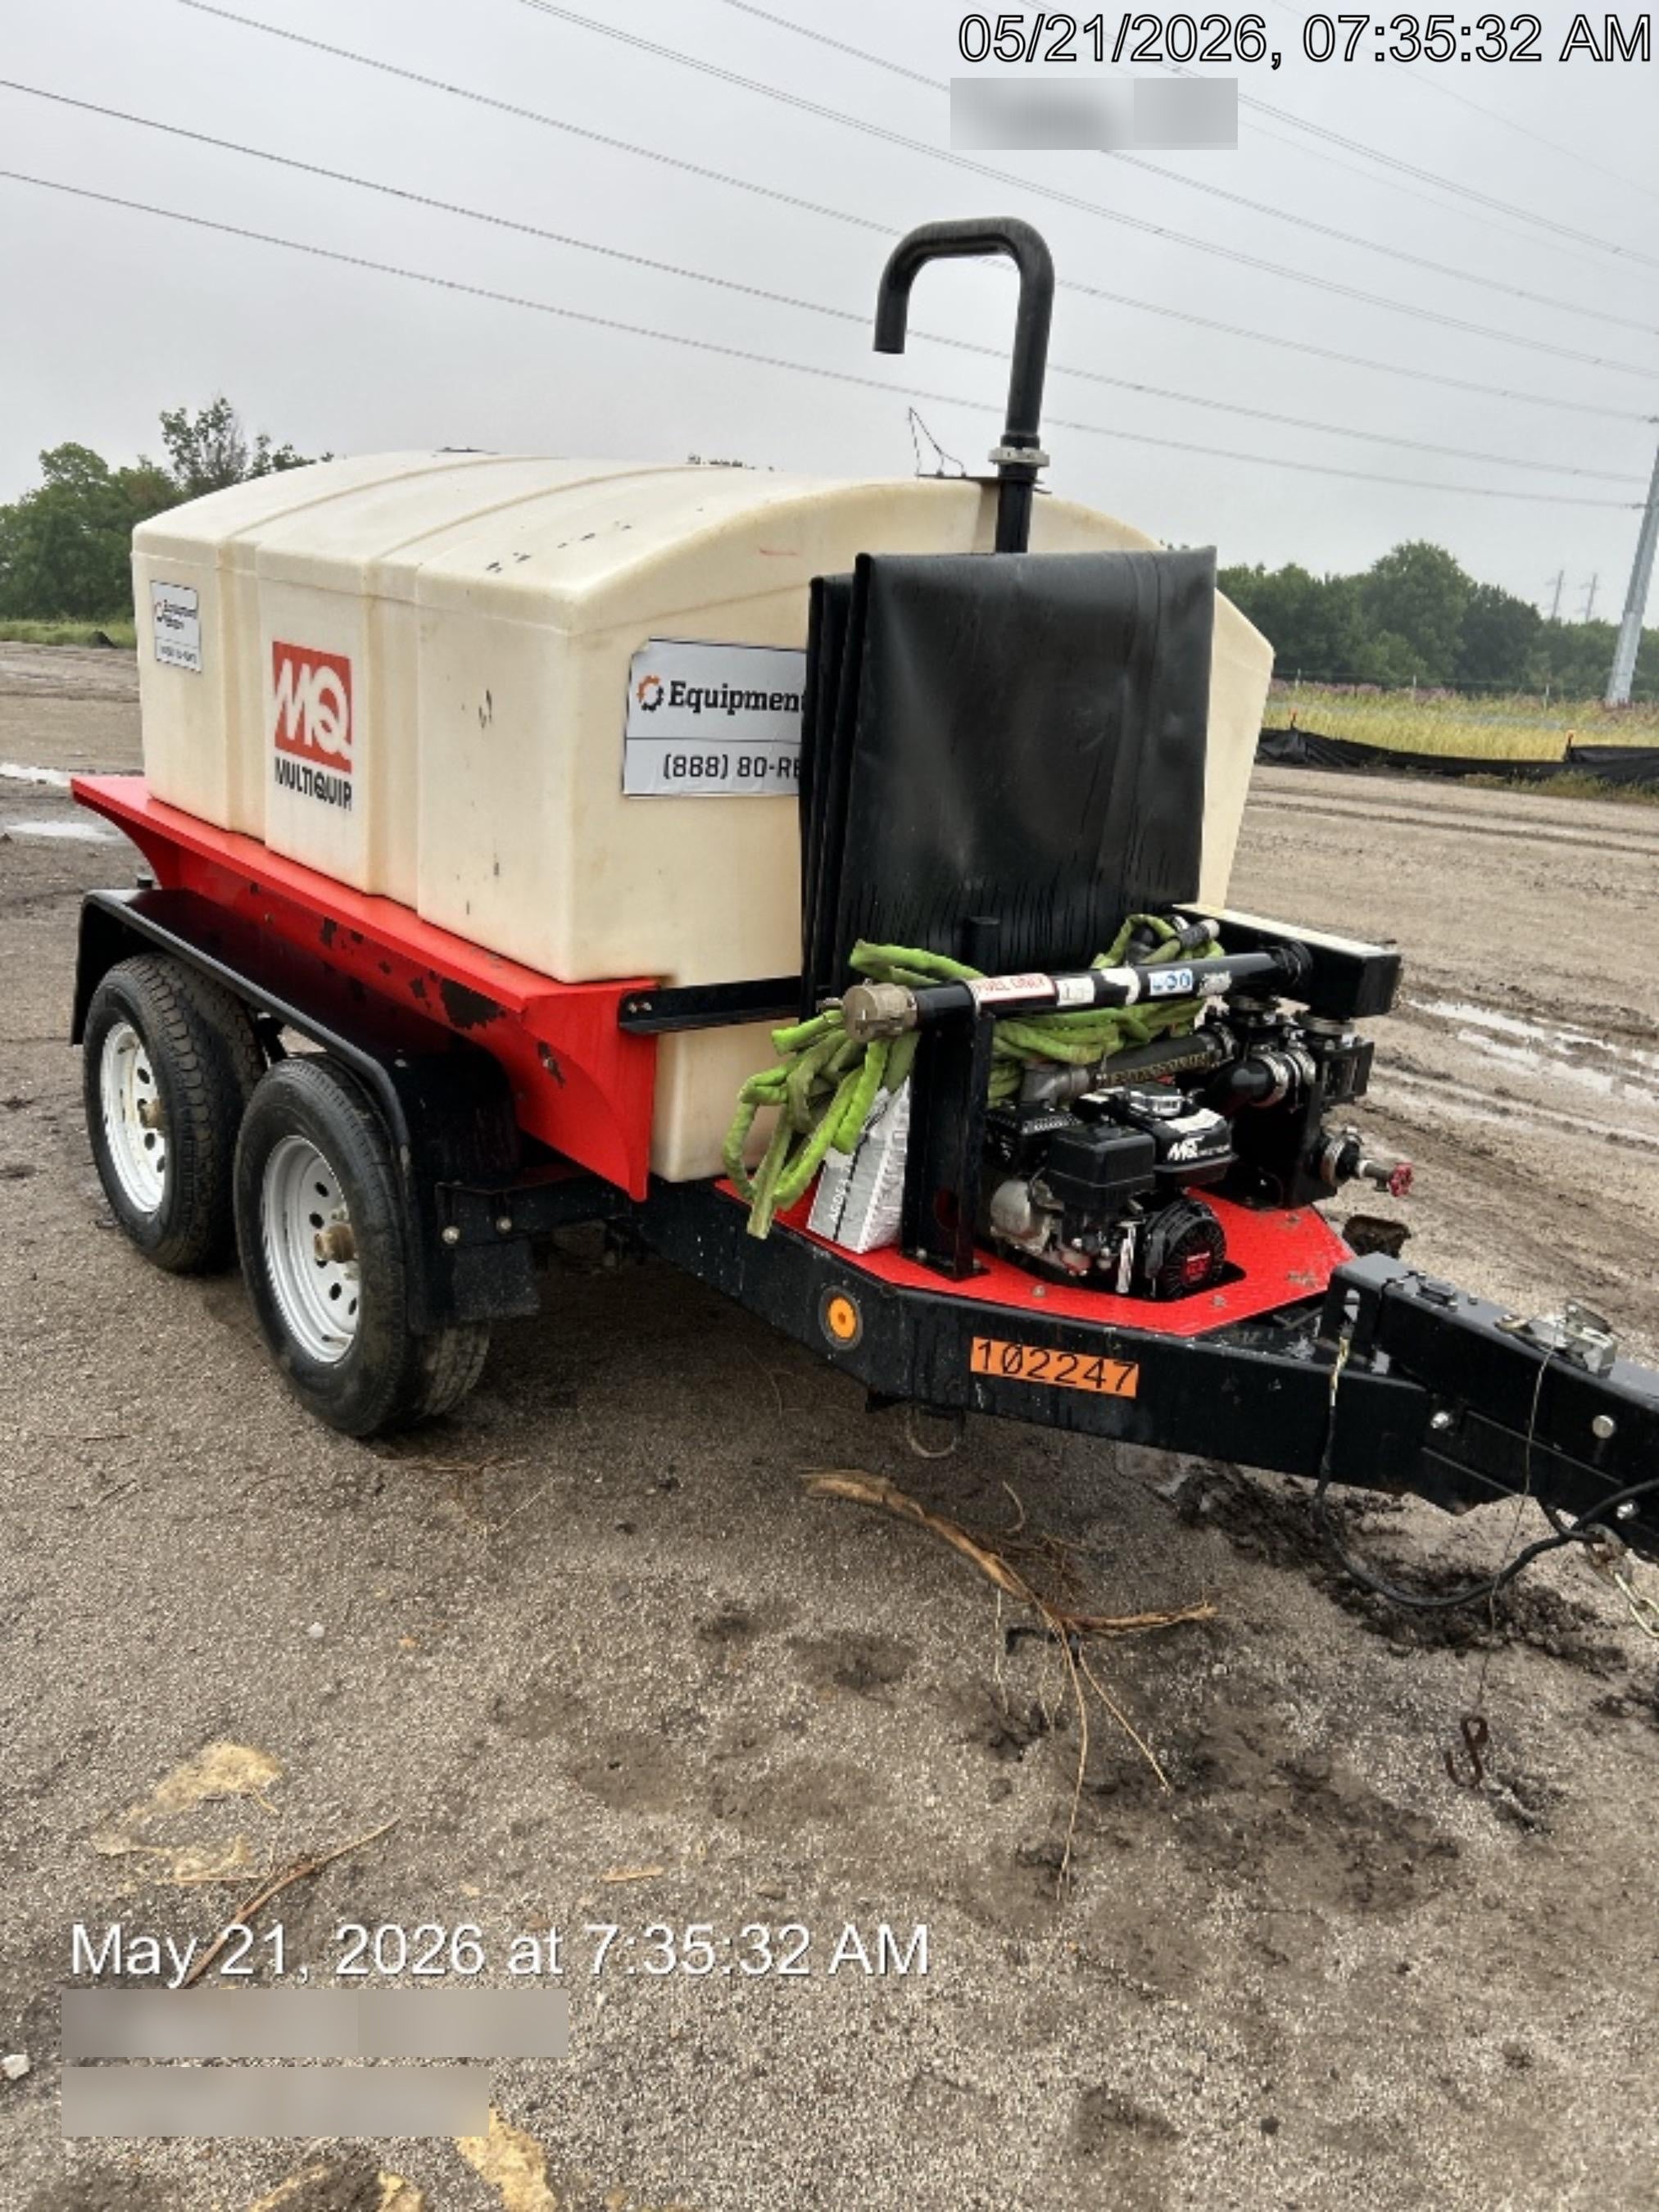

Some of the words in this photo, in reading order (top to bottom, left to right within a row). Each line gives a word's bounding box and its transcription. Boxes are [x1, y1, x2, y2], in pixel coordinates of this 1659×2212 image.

[273, 655, 352, 762] MQ
[668, 681, 806, 715] Equipmen
[663, 754, 728, 779] (888)
[977, 1340, 1137, 1392] 102247
